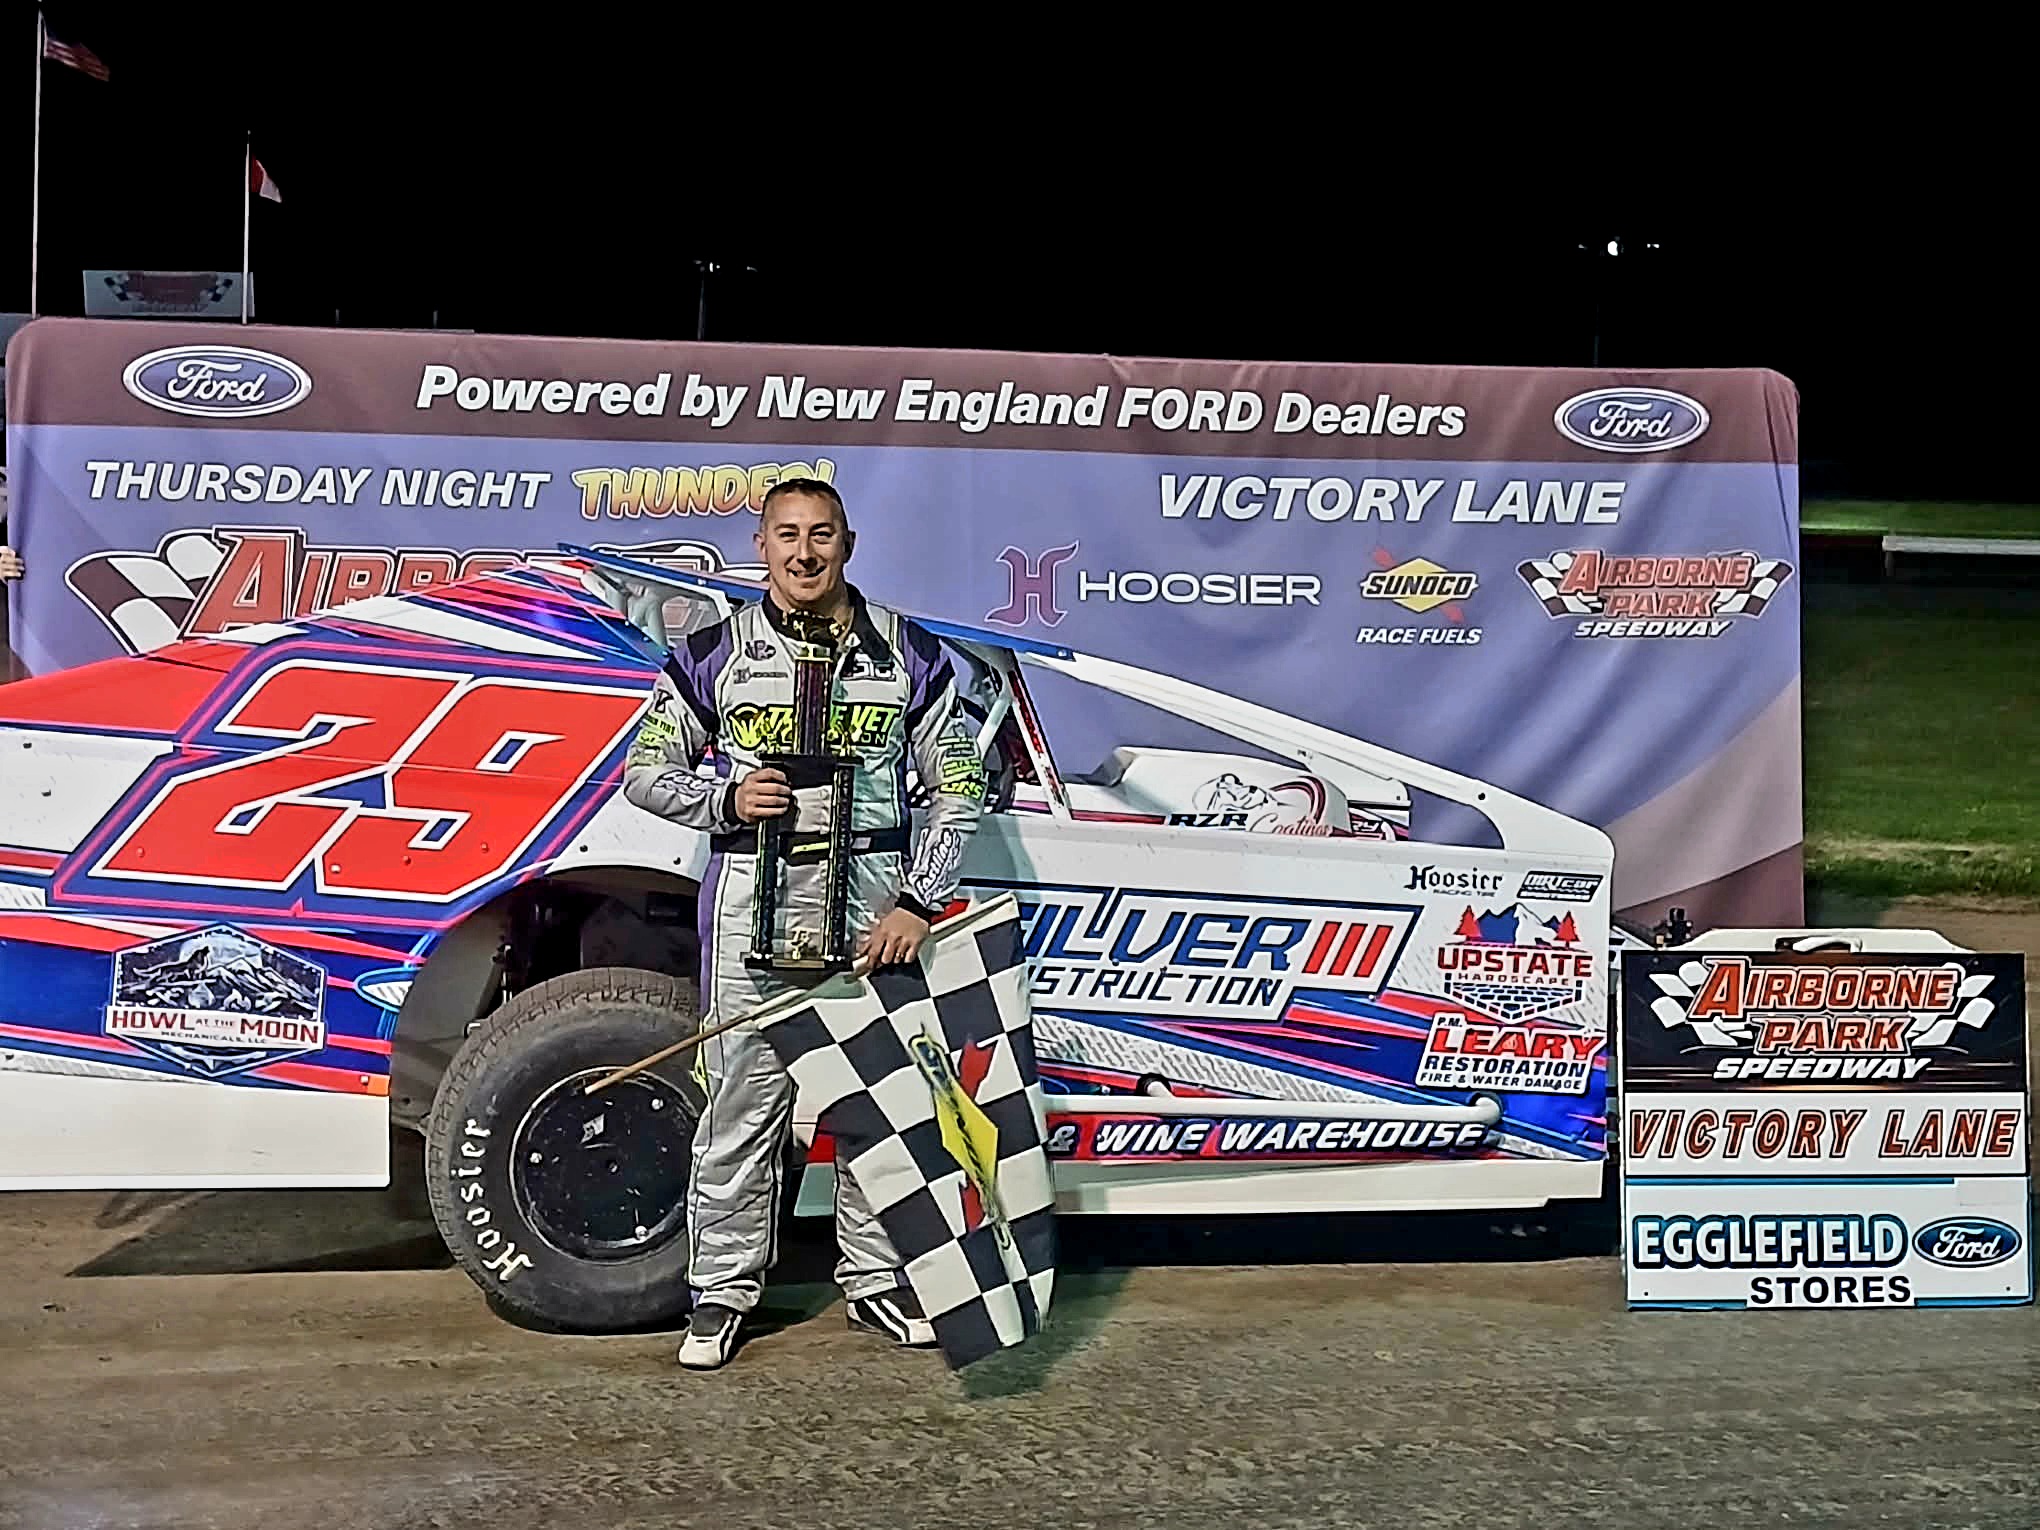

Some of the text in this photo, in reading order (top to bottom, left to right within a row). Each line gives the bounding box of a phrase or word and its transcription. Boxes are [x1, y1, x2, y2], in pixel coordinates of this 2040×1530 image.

[167, 359, 267, 404] Ford
[416, 365, 1466, 437] Powered by New England FORD Dealers
[1588, 400, 1673, 440] Ford
[86, 460, 551, 509] THURSDAY NIGHT
[1159, 474, 1626, 524] VICTORY LANE
[1080, 570, 1321, 607] HOOSIER
[1365, 573, 1475, 598] SUNOCO
[1559, 549, 1752, 594] AIRBORNE
[1604, 589, 1714, 618] PARK
[1356, 627, 1482, 645] RACE FUELS
[1574, 621, 1731, 637] SPEEDWAY
[88, 658, 652, 903] 29
[1168, 813, 1248, 827] RZR
[1403, 865, 1503, 890] Hoosier
[1438, 947, 1592, 978] UPSTATE
[1028, 965, 1282, 1008] STRUCTION
[1457, 973, 1569, 987] HARDSCAPE
[1686, 956, 1964, 1021] AIRBORNE
[111, 1009, 195, 1031] HOWL
[240, 1018, 319, 1044] MOON
[1437, 1016, 1463, 1028] P.M.
[1755, 1015, 1910, 1054] PARK
[1429, 1028, 1604, 1061] LEARY
[1420, 1072, 1581, 1090] FIRE & WATER DAMAGE
[1424, 1055, 1586, 1077] RESTORATION
[1713, 1057, 1931, 1080] SPEEDWAY
[1048, 1121, 1485, 1153] & WINE WAREHOUSE
[1629, 1108, 2021, 1159] VICTORY LANE
[450, 1119, 535, 1281] Hoosier
[1634, 1217, 1906, 1267] EGGLEFIELD
[1931, 1227, 2001, 1261] Ford
[1750, 1275, 1912, 1305] STORES
